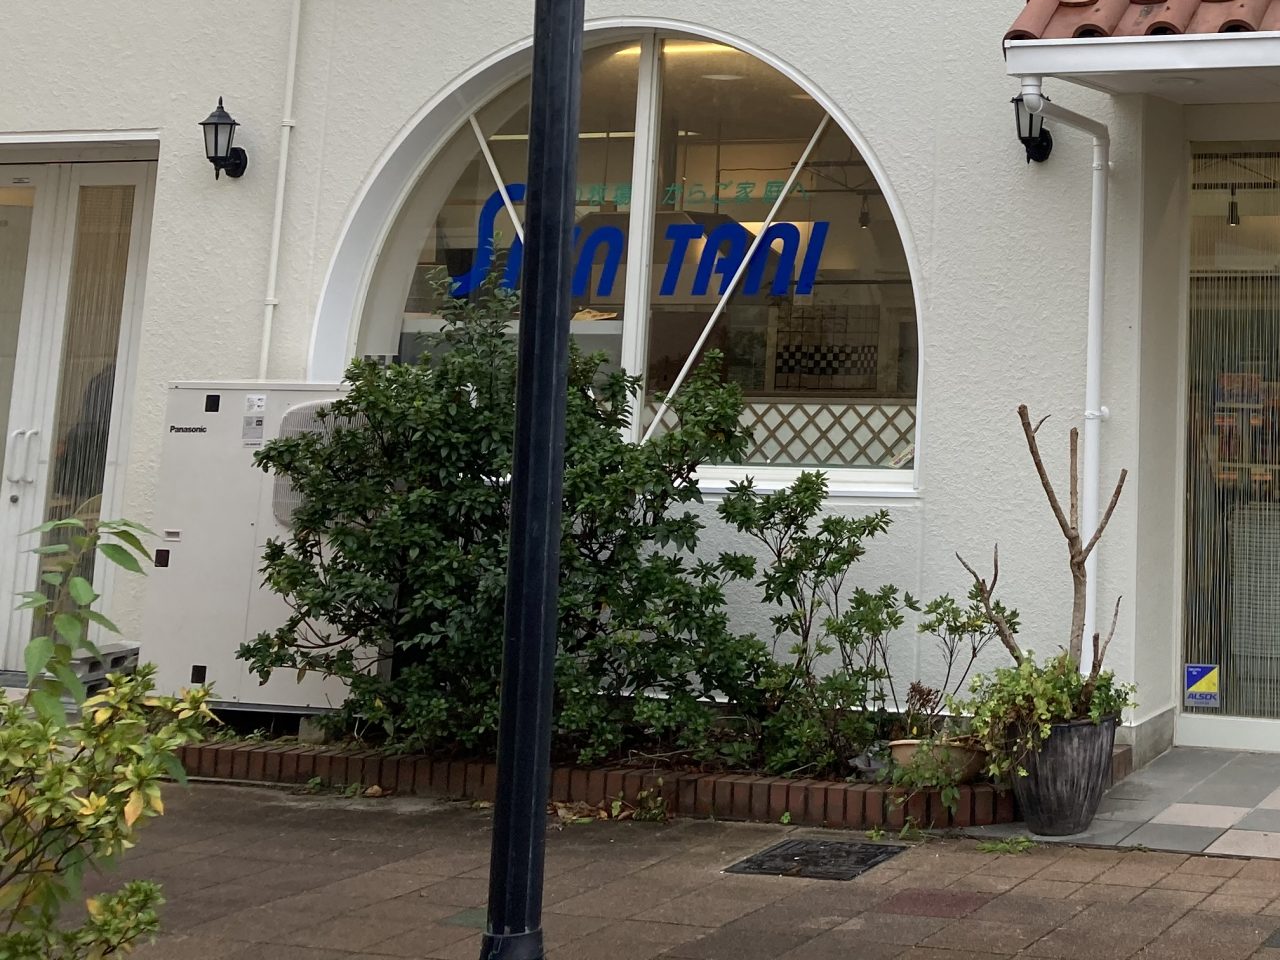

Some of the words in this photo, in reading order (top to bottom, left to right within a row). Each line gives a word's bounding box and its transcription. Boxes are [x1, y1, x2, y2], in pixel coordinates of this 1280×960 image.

[659, 221, 829, 296] TANI
[169, 425, 207, 433] Panasonic
[1187, 693, 1217, 701] ALSOK
